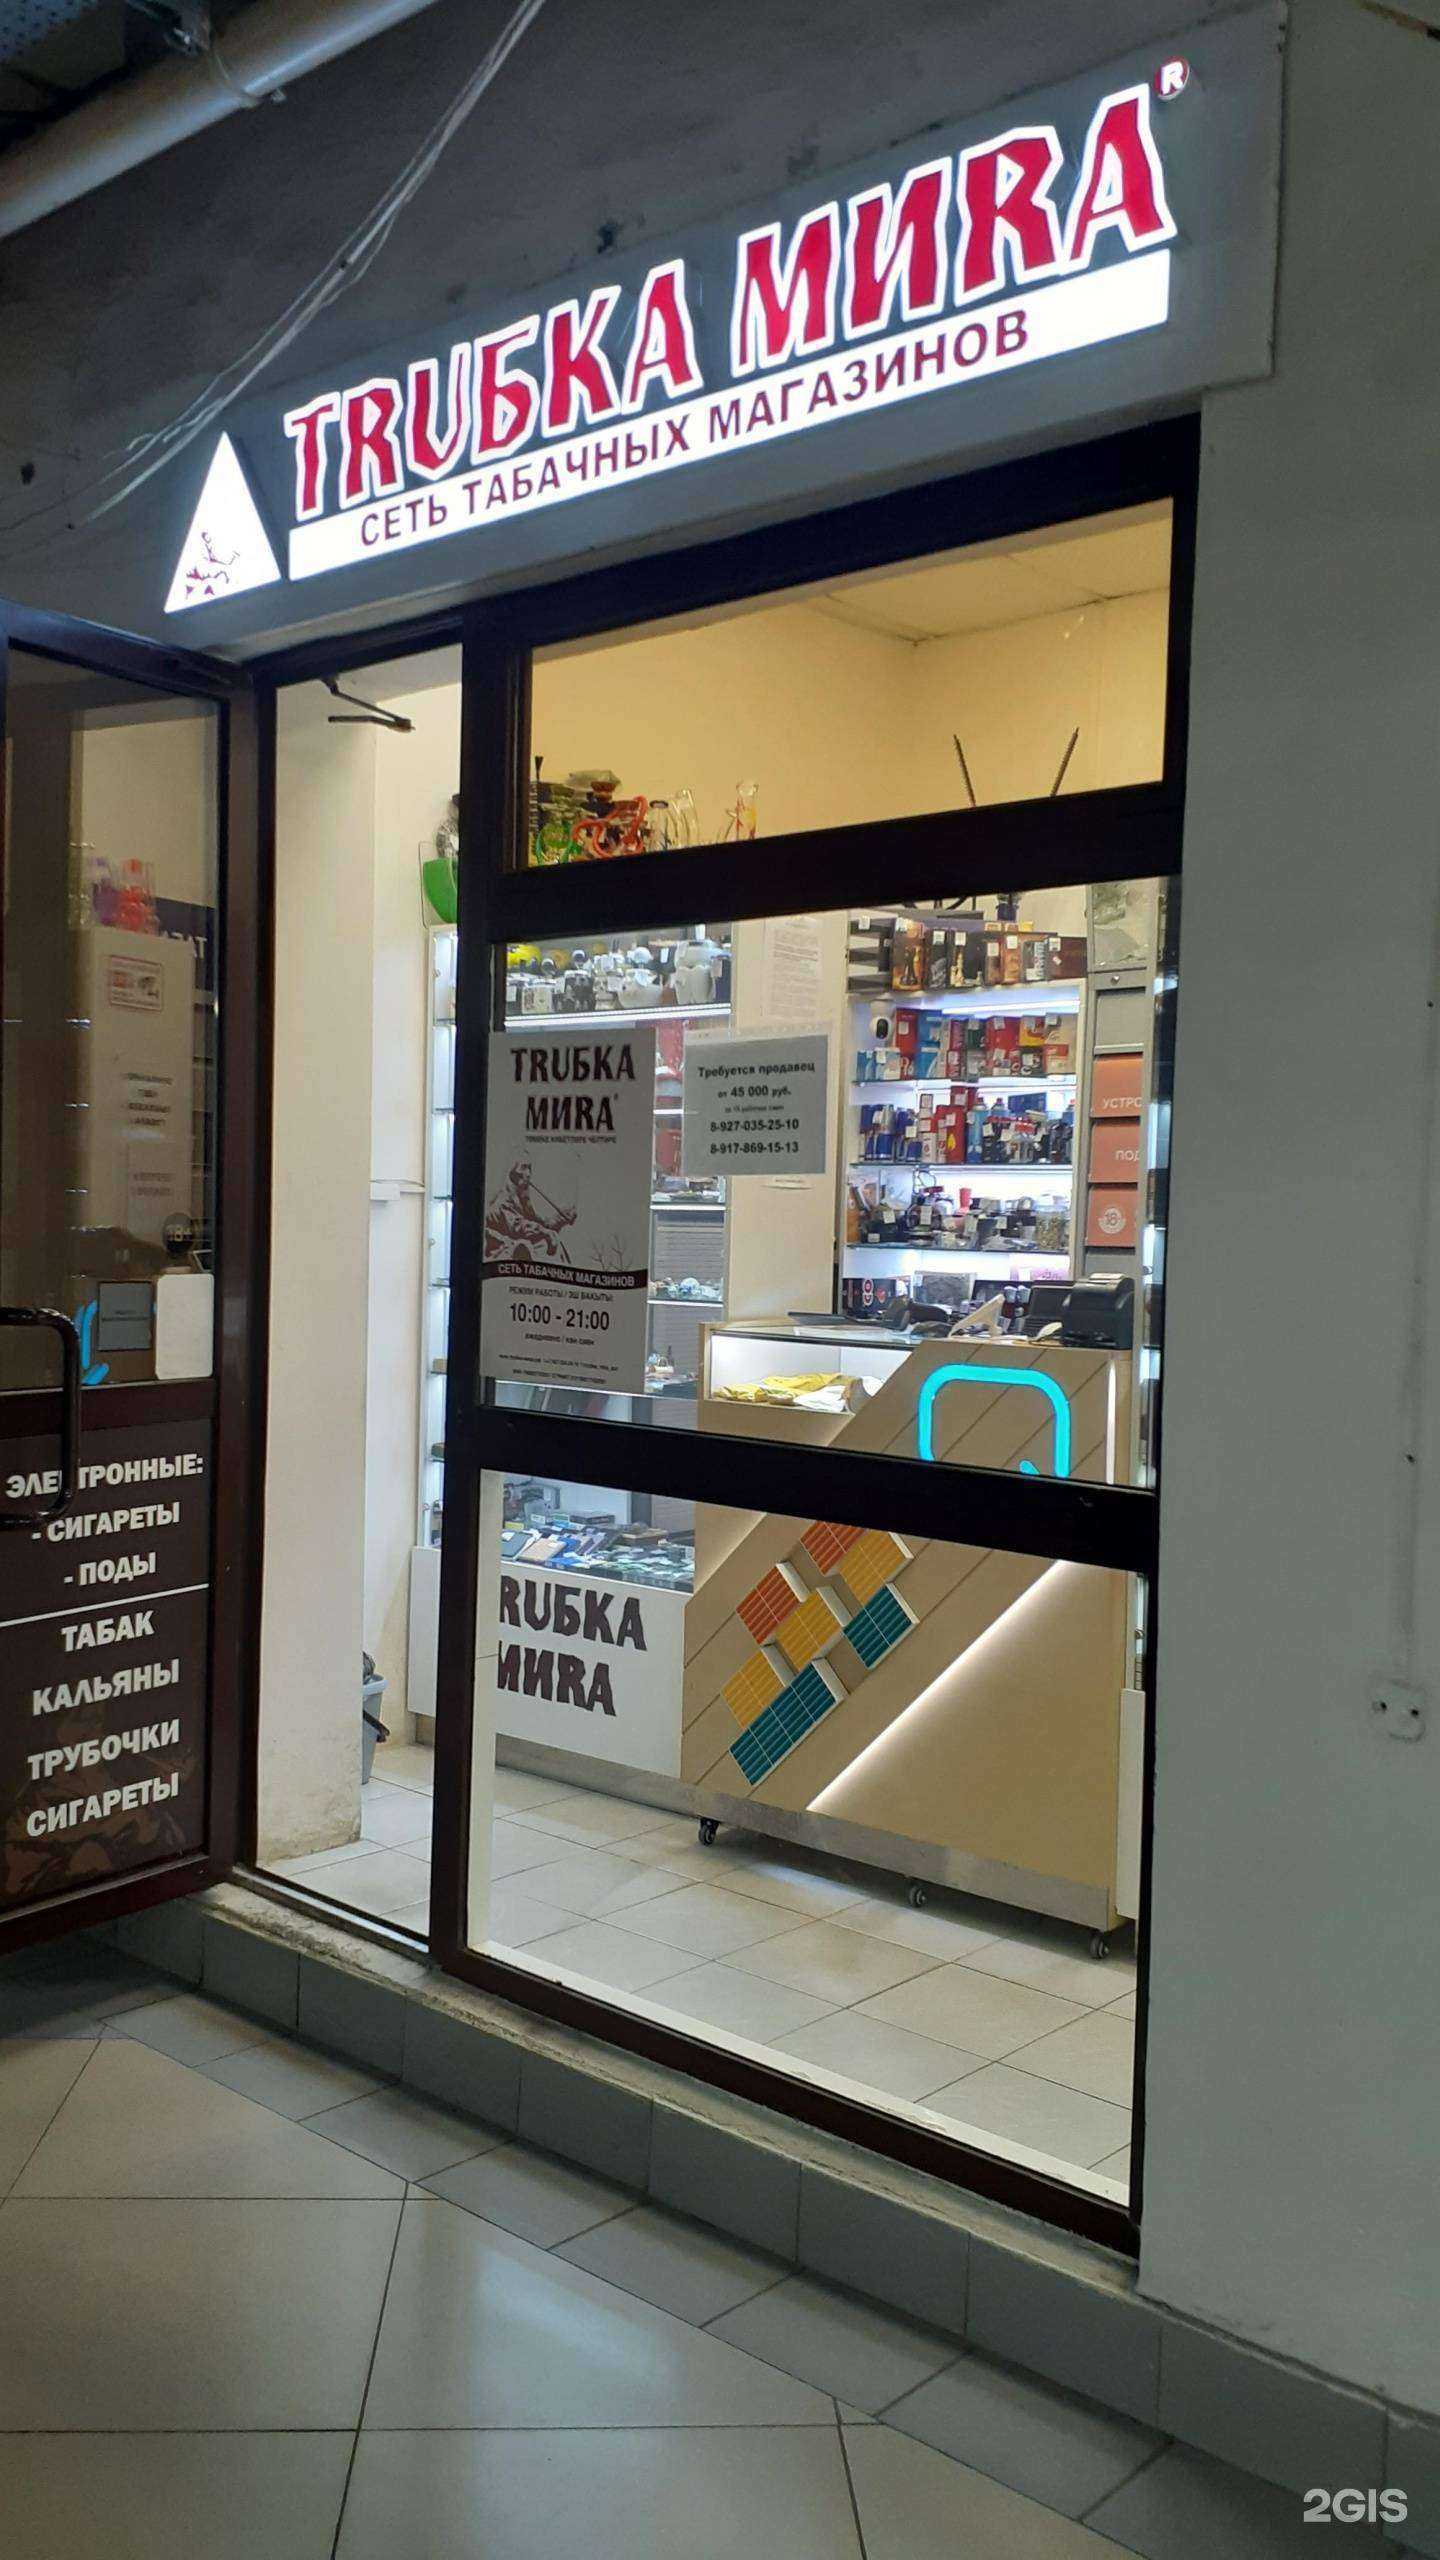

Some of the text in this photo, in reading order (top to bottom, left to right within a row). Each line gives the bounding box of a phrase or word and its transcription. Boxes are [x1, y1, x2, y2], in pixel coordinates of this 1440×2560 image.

[360, 308, 1029, 547] СЕТЬ ТАБАЧНЫХ МАГАЗИНОВ
[698, 1062, 815, 1079] Требуется продавец
[731, 1086, 745, 1098] 45
[748, 1085, 769, 1097] 000
[772, 1086, 791, 1098] руб.
[710, 1119, 799, 1132] 8-927-035-25-10
[710, 1141, 799, 1155] 8-917-869-15-13
[498, 1263, 635, 1287] СЕТЬ ТАБАЧНЫХ МАГАЗИНОВ
[510, 1302, 551, 1324] 10:00
[566, 1308, 610, 1331] 21:00
[5, 1453, 203, 1499] ЭЛЕТРОННЫЕ:
[47, 1502, 180, 1542] СИГАРЕТЫ
[79, 1552, 156, 1586] ПОДЫ
[61, 1610, 155, 1653] ТАБАК
[499, 1575, 648, 1651] RUБКА
[32, 1659, 180, 1716] КАЛЬЯНЫ
[28, 1718, 180, 1780] ТРУБОЧКИ
[26, 1773, 179, 1838] СИГАРЕТЫ
